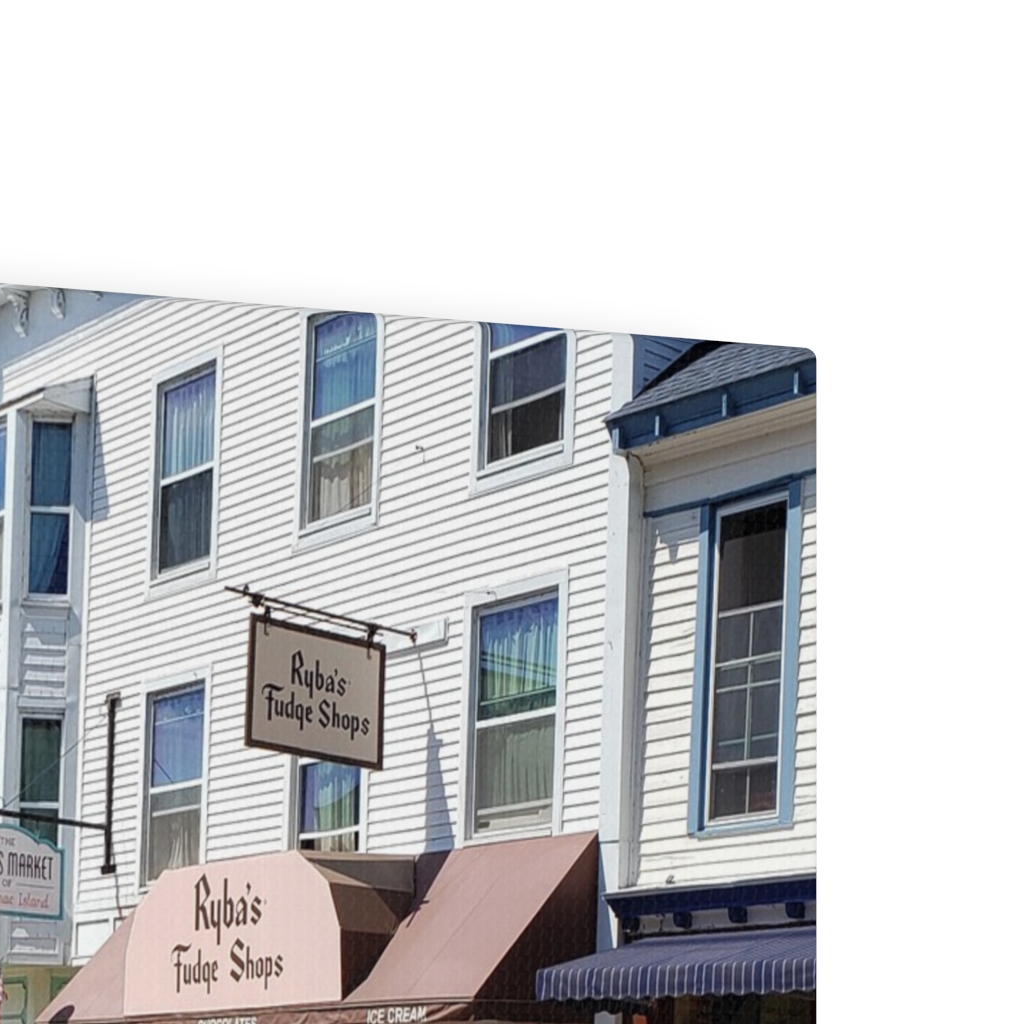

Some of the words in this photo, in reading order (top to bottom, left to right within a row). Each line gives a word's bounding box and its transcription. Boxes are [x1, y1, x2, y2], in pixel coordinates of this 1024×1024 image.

[291, 650, 347, 699] Ryba's
[261, 683, 313, 731] Fudge
[318, 698, 370, 741] Shops
[0, 836, 16, 846] THE
[8, 853, 54, 880] MARKET
[1, 878, 13, 887] OF
[18, 892, 49, 909] Island
[194, 873, 263, 945] Ryba's
[171, 942, 219, 994] Fudge
[229, 938, 284, 990] Shops
[367, 1008, 385, 1024] ICE
